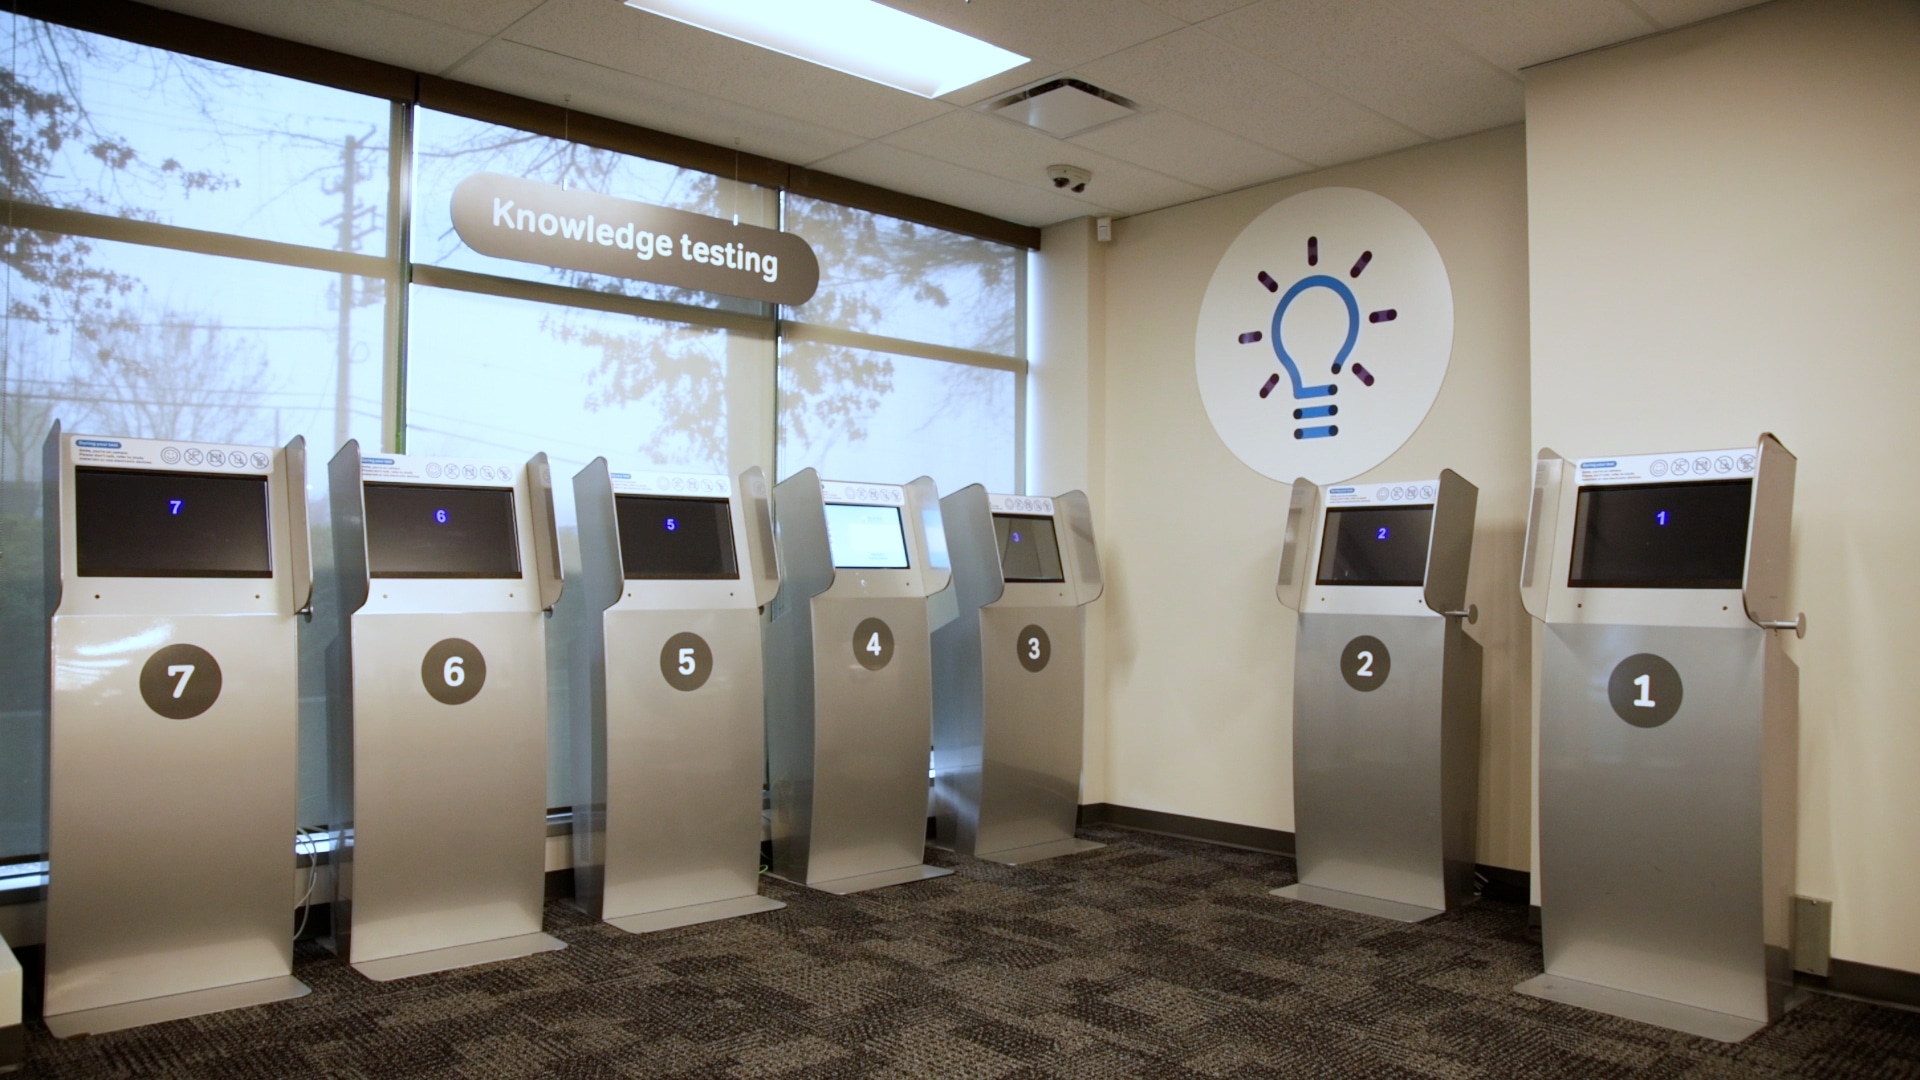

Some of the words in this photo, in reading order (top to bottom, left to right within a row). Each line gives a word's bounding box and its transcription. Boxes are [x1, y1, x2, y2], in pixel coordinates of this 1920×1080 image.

[492, 197, 673, 261] Knowledge
[680, 234, 779, 283] testing
[170, 499, 182, 515] 7
[436, 509, 447, 524] 6
[1657, 511, 1667, 526] 1
[666, 518, 675, 532] 5
[1012, 532, 1021, 542] 3
[1377, 527, 1388, 540] 2
[866, 631, 882, 656] 4
[1028, 637, 1041, 660] 3
[443, 656, 465, 687] 6
[678, 647, 696, 675] 5
[1356, 650, 1374, 677] 2
[167, 664, 195, 699] 7
[1633, 674, 1656, 708] 1
